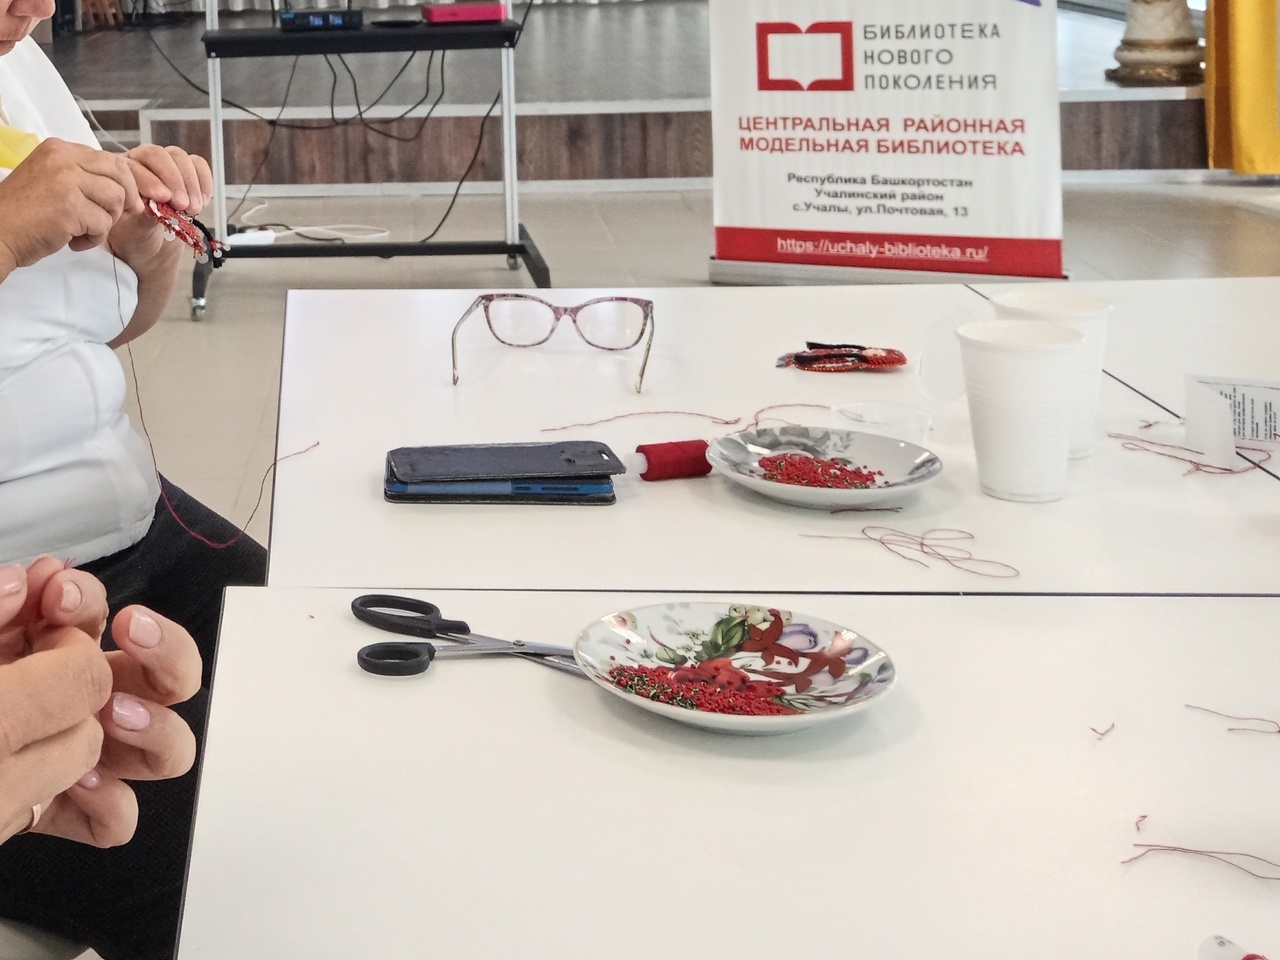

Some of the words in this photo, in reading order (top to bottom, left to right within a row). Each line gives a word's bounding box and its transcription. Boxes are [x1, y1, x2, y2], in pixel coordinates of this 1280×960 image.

[863, 23, 1001, 40] БИБЛИОТЕКА
[863, 48, 954, 65] НОВОГО
[864, 74, 998, 90] ПОКОЛЕНИЯ
[738, 115, 890, 134] ЦЕНТРАЛЬНАЯ
[903, 115, 1026, 135] РАЙОННАЯ
[739, 137, 869, 154] МОДЕЛЬНАЯ
[876, 139, 1026, 156] БИБЛИОТЕКА
[787, 172, 867, 187] Республика
[871, 174, 973, 189] Башкортостан
[814, 188, 897, 202] Учалинский
[901, 191, 944, 204] район
[953, 206, 969, 218] 13
[776, 237, 989, 261] https://uchaly-biblioteka.ru/
